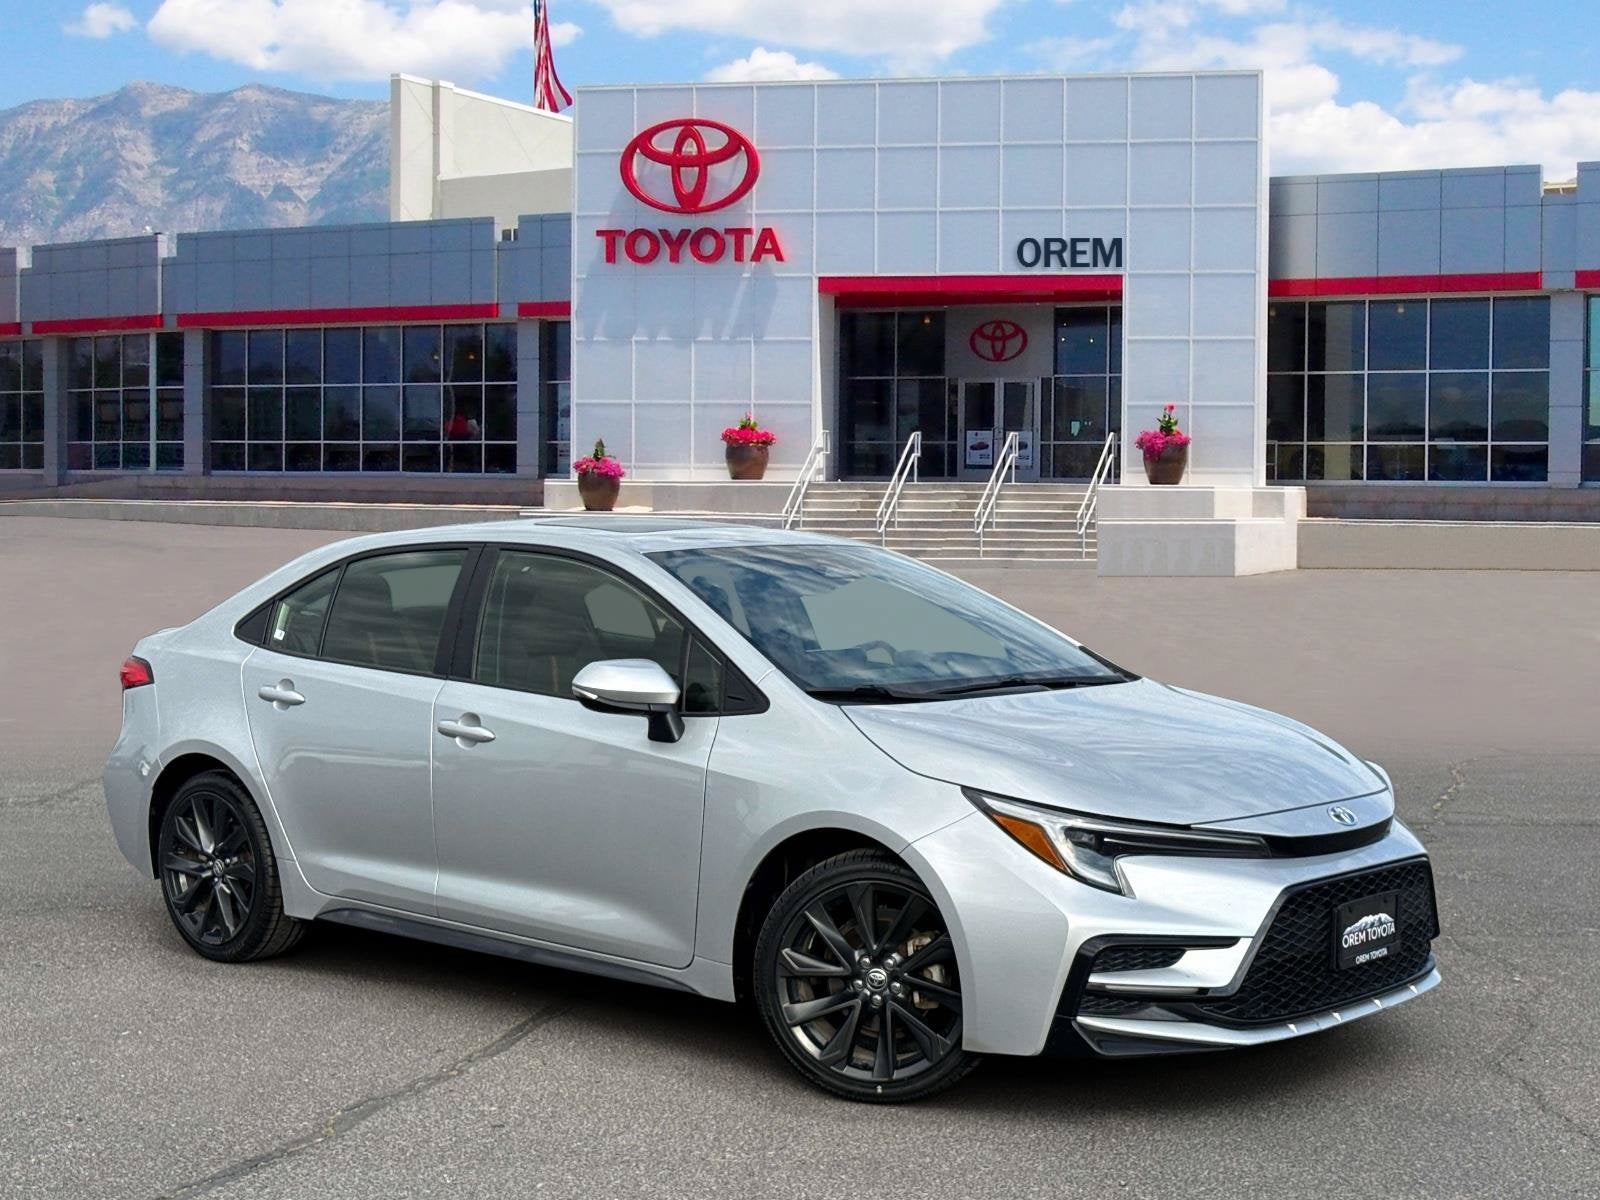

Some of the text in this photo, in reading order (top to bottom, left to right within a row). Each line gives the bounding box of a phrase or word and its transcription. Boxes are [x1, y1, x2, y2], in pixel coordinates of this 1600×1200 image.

[596, 227, 785, 264] TOYOTA
[1016, 237, 1123, 268] OREM
[1342, 922, 1396, 948] OREM TOYOTA
[1355, 947, 1388, 965] OREM TOYOTA
